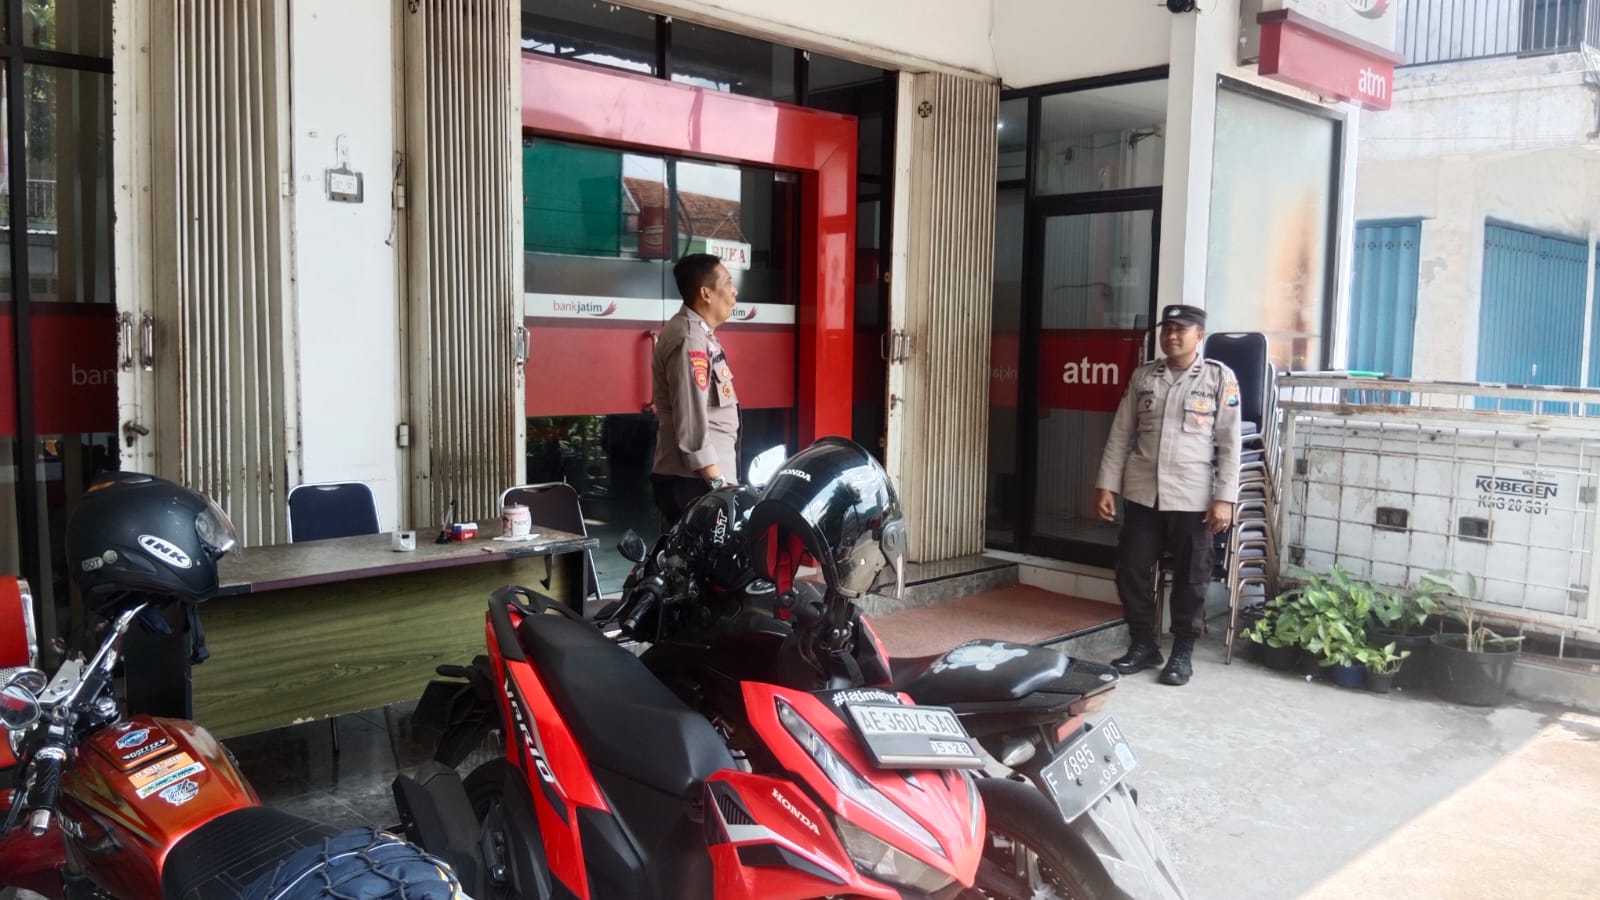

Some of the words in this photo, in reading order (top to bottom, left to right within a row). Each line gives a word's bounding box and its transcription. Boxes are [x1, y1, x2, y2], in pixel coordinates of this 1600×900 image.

[1358, 67, 1386, 99] atm
[553, 300, 602, 314] bankjatim
[1062, 356, 1119, 385] atm
[1475, 478, 1558, 500] KOBEGEN
[144, 539, 187, 563] INK
[504, 678, 554, 783] VARIO
[860, 711, 885, 731] AE
[884, 712, 926, 732] 3604
[1063, 743, 1095, 781] 4895
[771, 788, 821, 836] HONDA
